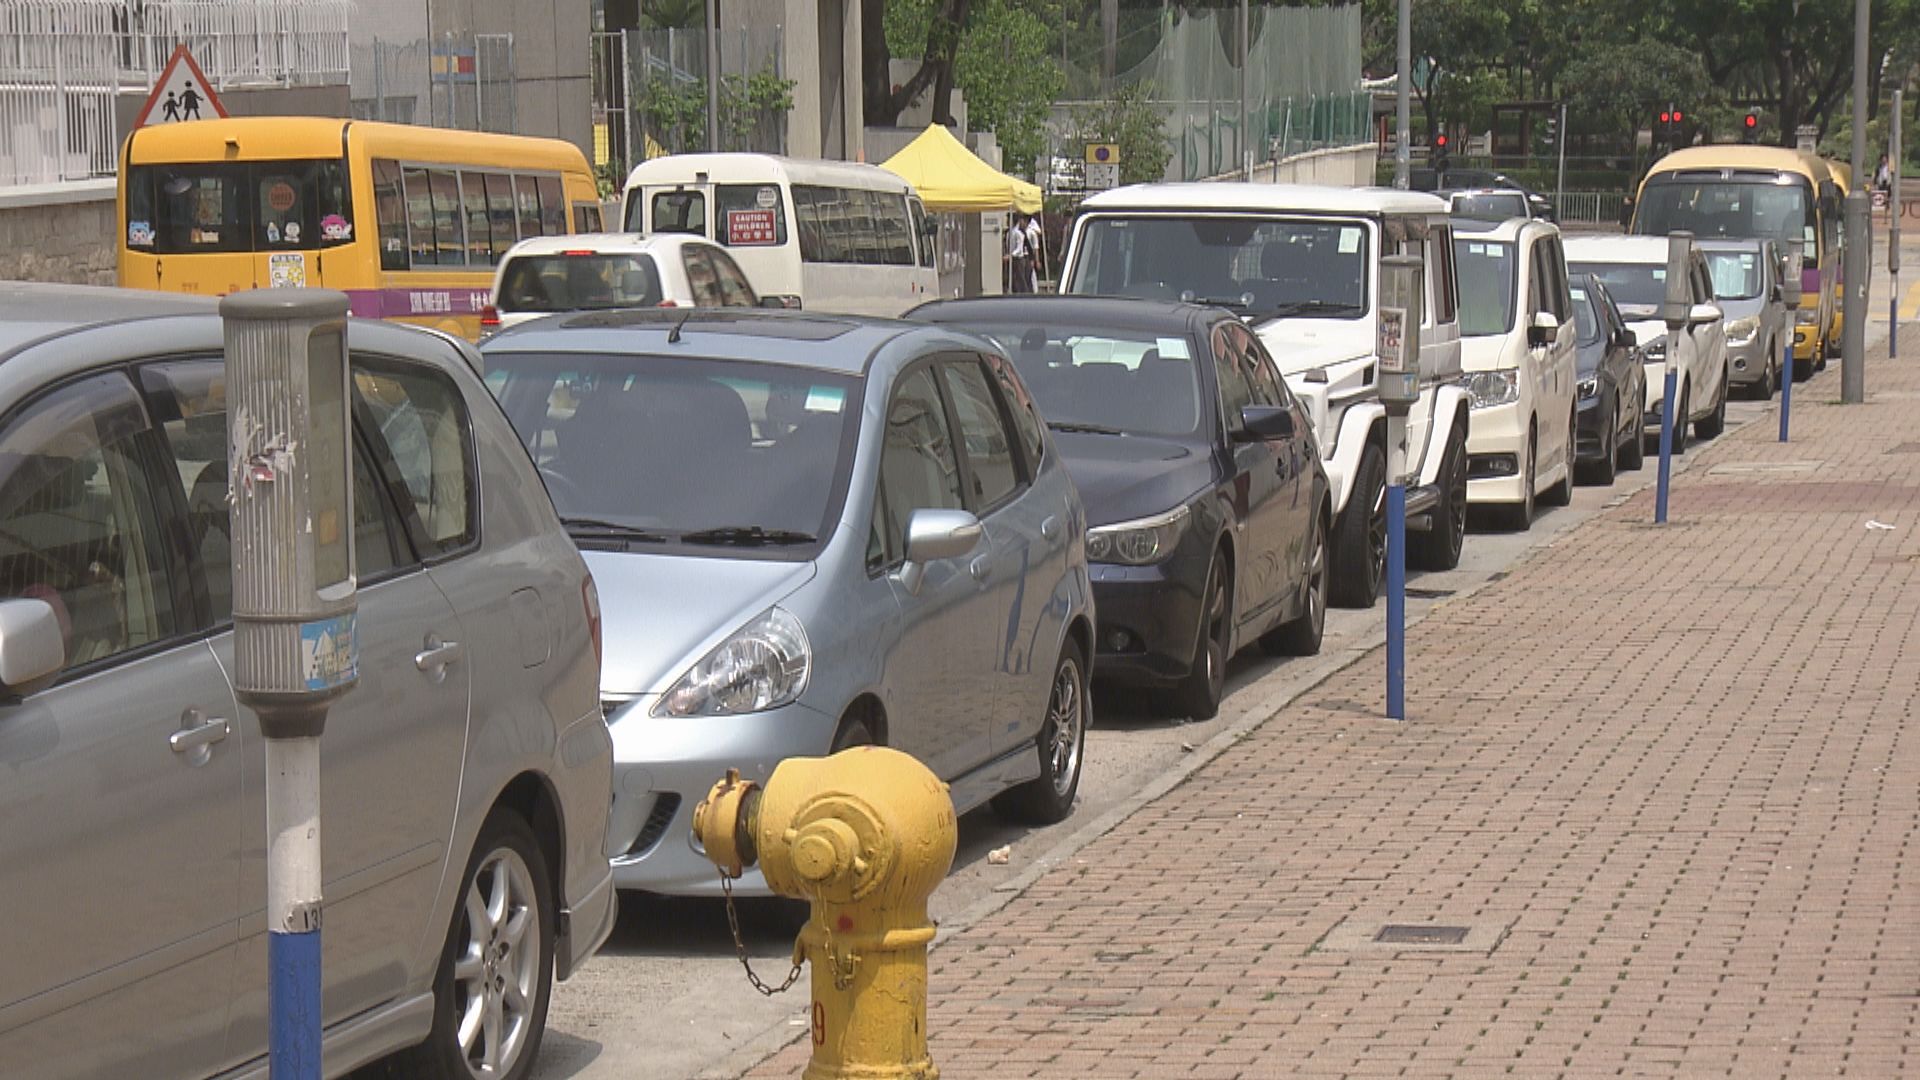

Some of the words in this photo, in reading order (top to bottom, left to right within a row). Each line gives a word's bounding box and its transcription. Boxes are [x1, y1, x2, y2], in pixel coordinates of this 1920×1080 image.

[735, 213, 768, 222] CAUTION
[733, 222, 771, 231] CHILDREN
[811, 1001, 825, 1046] 9
